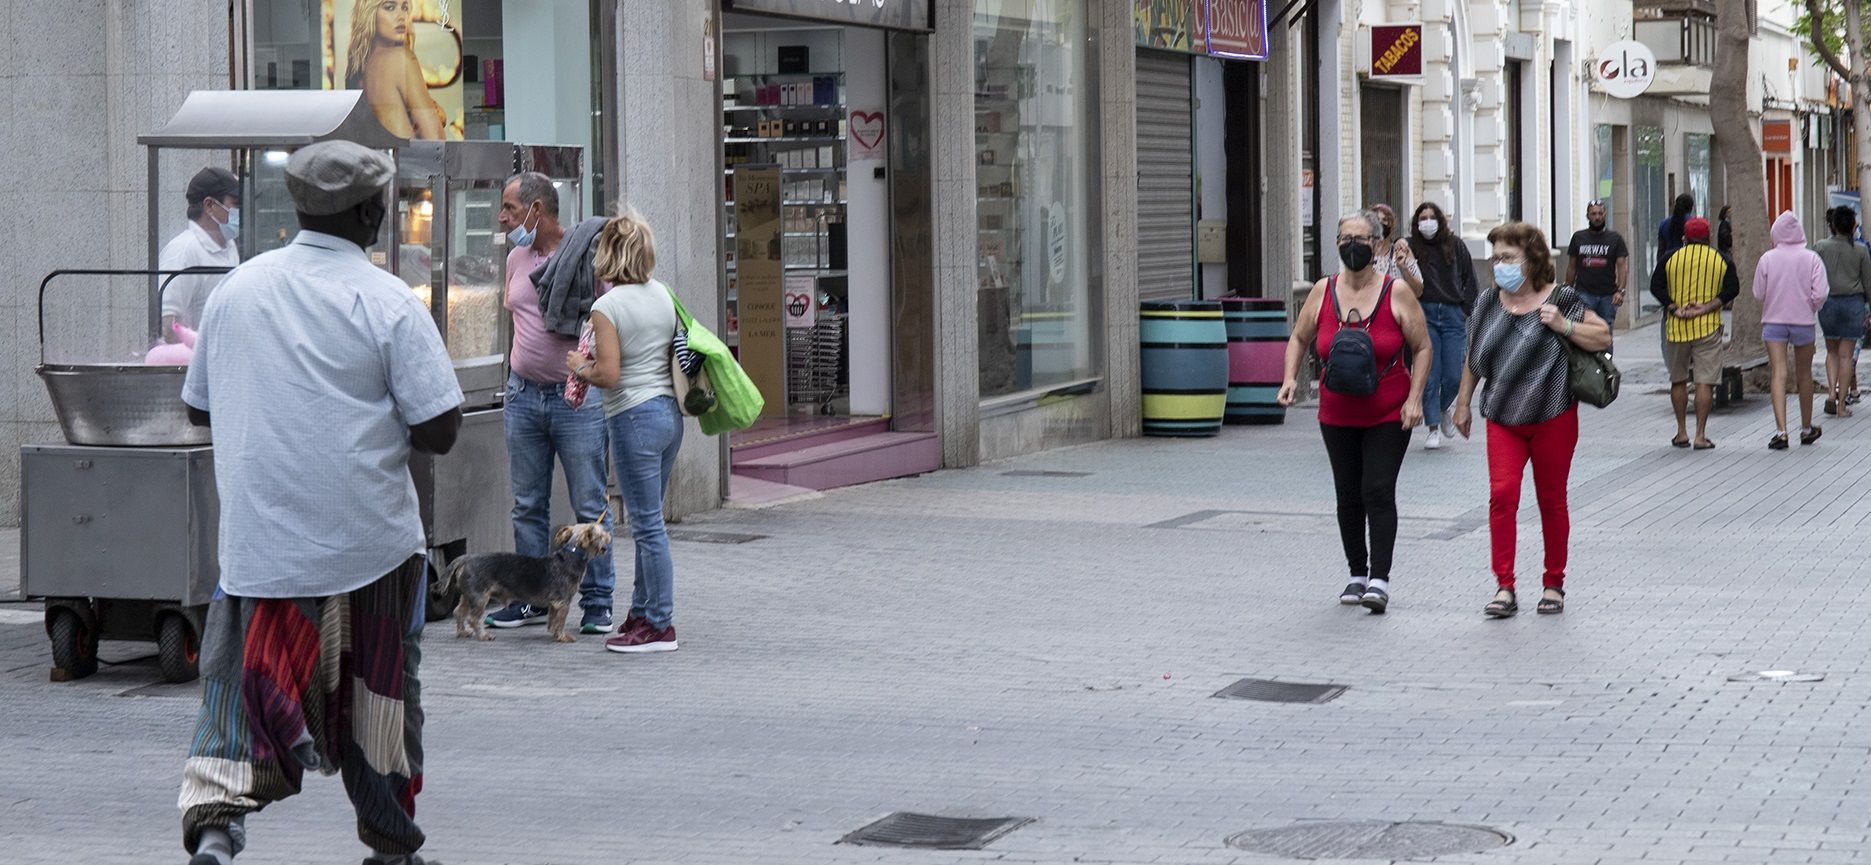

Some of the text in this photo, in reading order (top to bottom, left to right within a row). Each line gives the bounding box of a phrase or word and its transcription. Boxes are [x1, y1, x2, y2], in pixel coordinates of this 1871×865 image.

[1374, 28, 1419, 74] TABACOS
[745, 182, 770, 194] SPA
[1578, 244, 1610, 256] NORWAY
